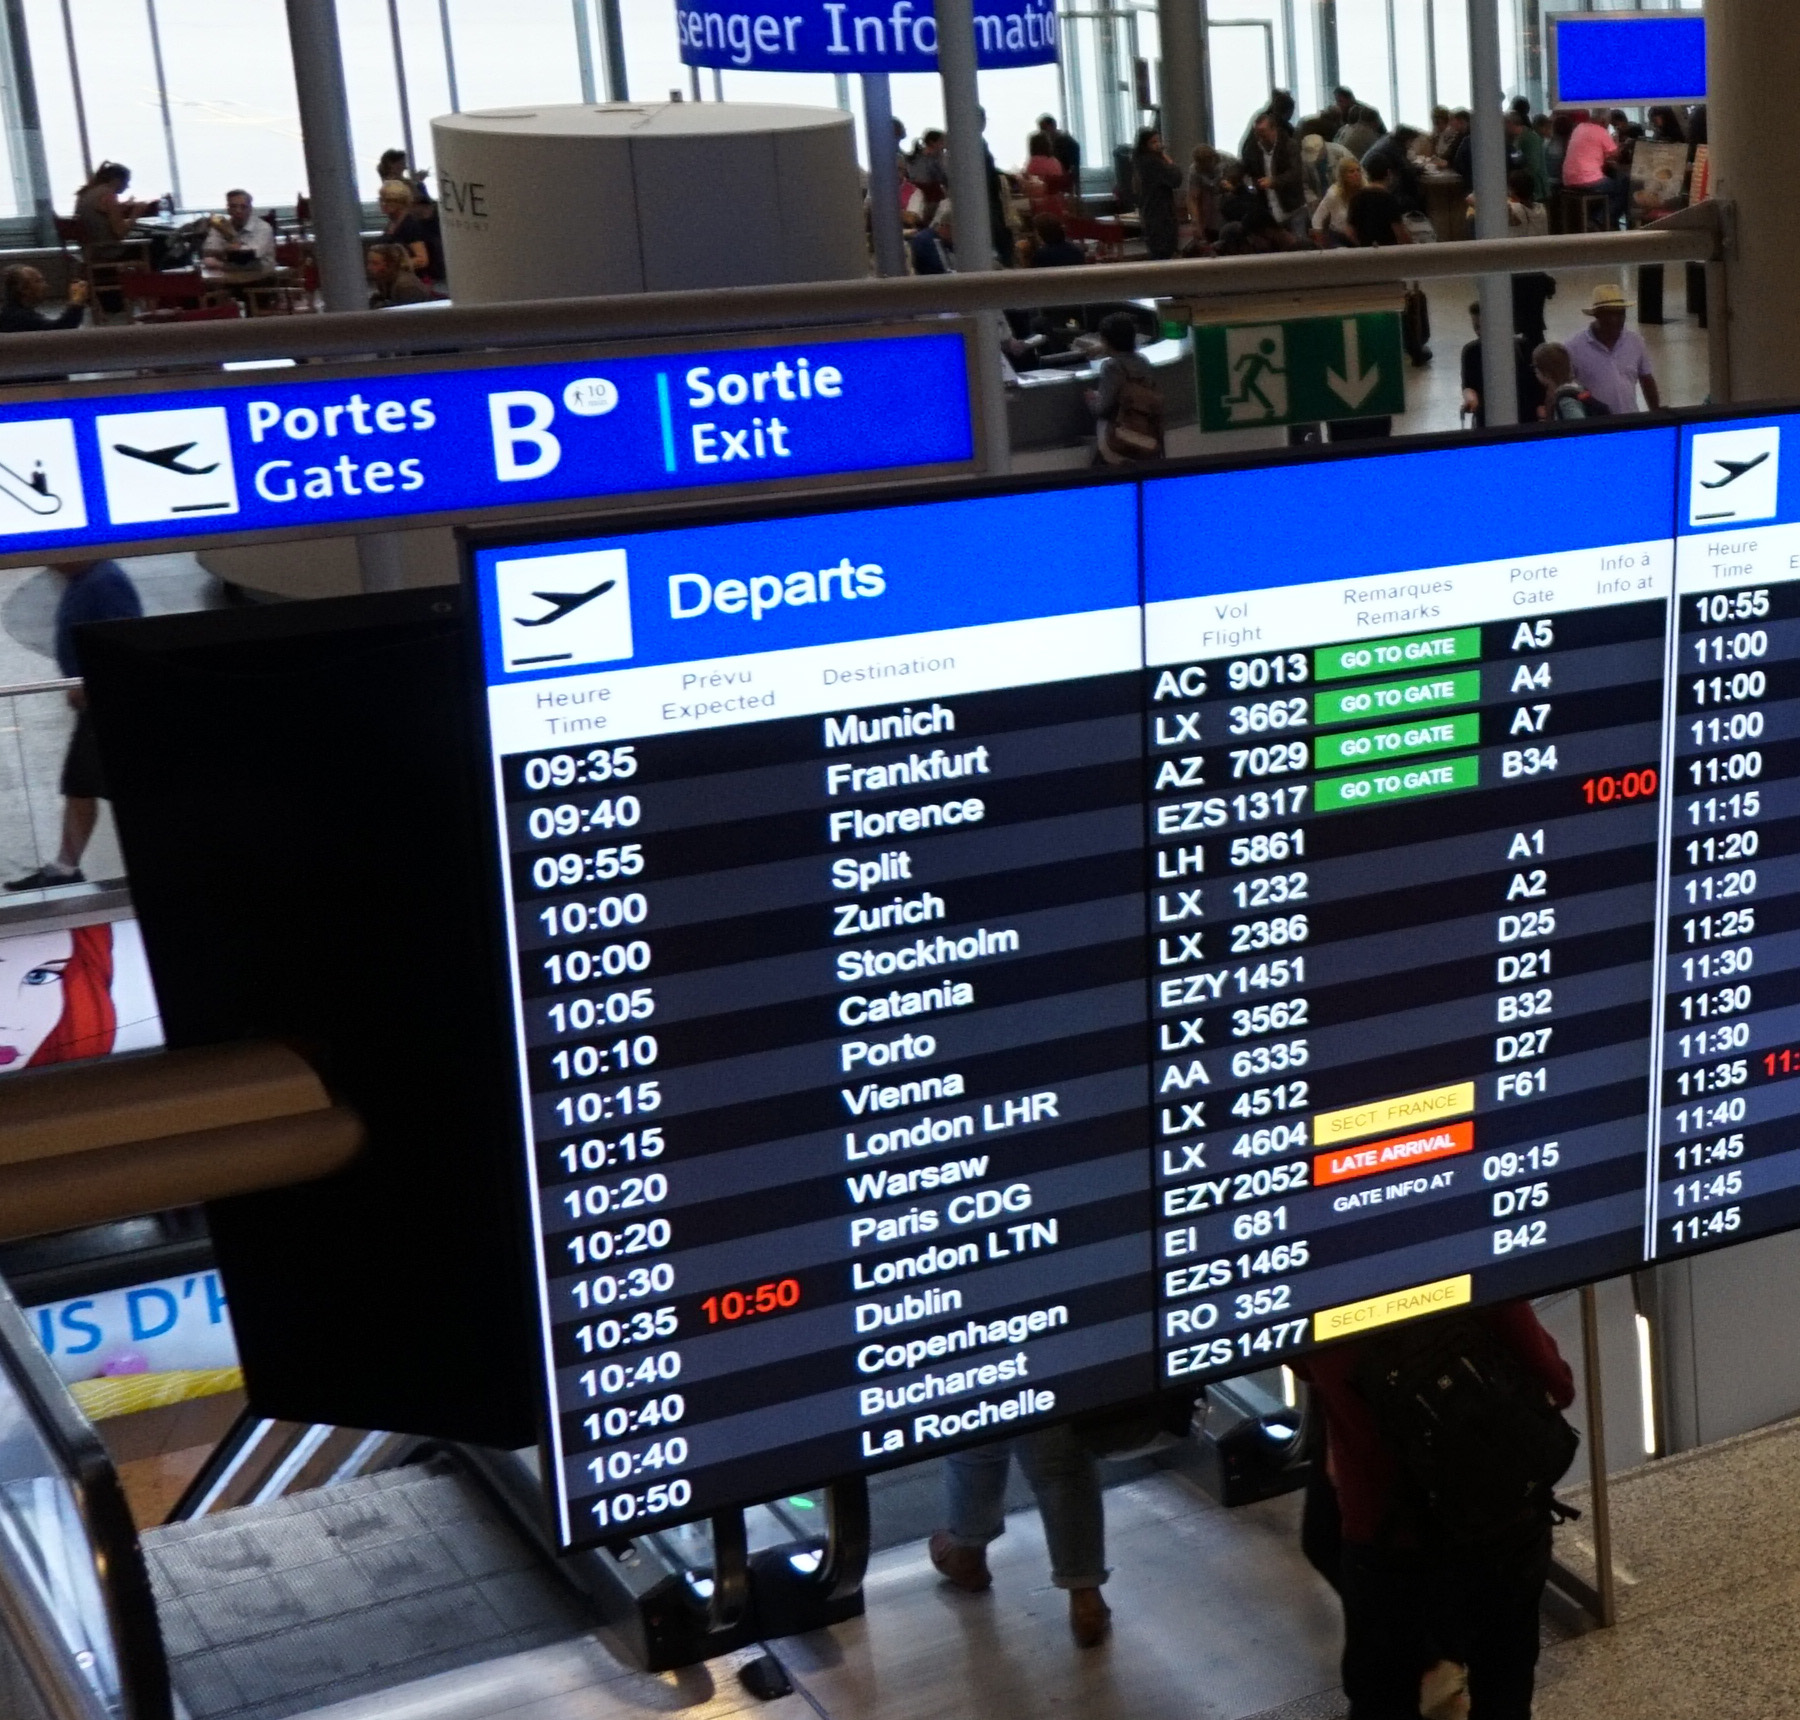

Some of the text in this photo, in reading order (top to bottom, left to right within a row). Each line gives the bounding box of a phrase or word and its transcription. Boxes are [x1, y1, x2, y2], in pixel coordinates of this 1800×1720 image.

[587, 384, 606, 397] 10
[686, 358, 842, 407] Sortie
[248, 395, 435, 442] Portes
[489, 391, 561, 481] B
[693, 418, 790, 463] Exit
[255, 455, 424, 502] Gates
[1601, 554, 1635, 571] Info
[1707, 540, 1758, 557] Heure
[669, 558, 885, 620] Departs
[1344, 580, 1453, 605] Remarques
[1510, 566, 1558, 583] Porte
[1215, 603, 1248, 620] Vol
[1356, 604, 1441, 627] Remarks
[1512, 590, 1555, 606] Gate
[1696, 590, 1769, 622] 10:55
[1202, 627, 1262, 648] Flight
[1341, 638, 1455, 668] GO TO GATE
[1512, 620, 1553, 650] A5
[682, 671, 752, 691] Prévu
[823, 657, 955, 686] Destination
[1154, 653, 1308, 700] AC 9013
[536, 688, 611, 709] Heure
[662, 690, 775, 721] Expected
[544, 715, 607, 735] Time
[825, 704, 954, 747] Munich
[525, 746, 637, 789] 09:35
[1503, 745, 1557, 778] B34
[1582, 769, 1657, 803] 10:00
[1158, 785, 1307, 834] EZS 1317
[832, 851, 912, 891] Split
[541, 893, 647, 936] 10:00
[837, 928, 1019, 985] Stockholm
[1678, 1060, 1747, 1095] 11:35
[1331, 1134, 1455, 1174] LATE ARRIVAL
[1483, 1142, 1559, 1180] 09:15
[1165, 1162, 1308, 1216] EZY 2052
[1334, 1171, 1454, 1211] GATE INFO AT
[1672, 1207, 1740, 1242] 11:45
[853, 1218, 1057, 1289] London LTN
[702, 1279, 800, 1323] 10:50
[1386, 1284, 1455, 1313] FRANCE
[576, 1307, 678, 1352] 10:35
[857, 1305, 1069, 1373] Copenhagen
[1168, 1318, 1308, 1376] EZS 1477
[863, 1389, 1055, 1456] La Rochelle
[592, 1479, 691, 1525] 10:50
